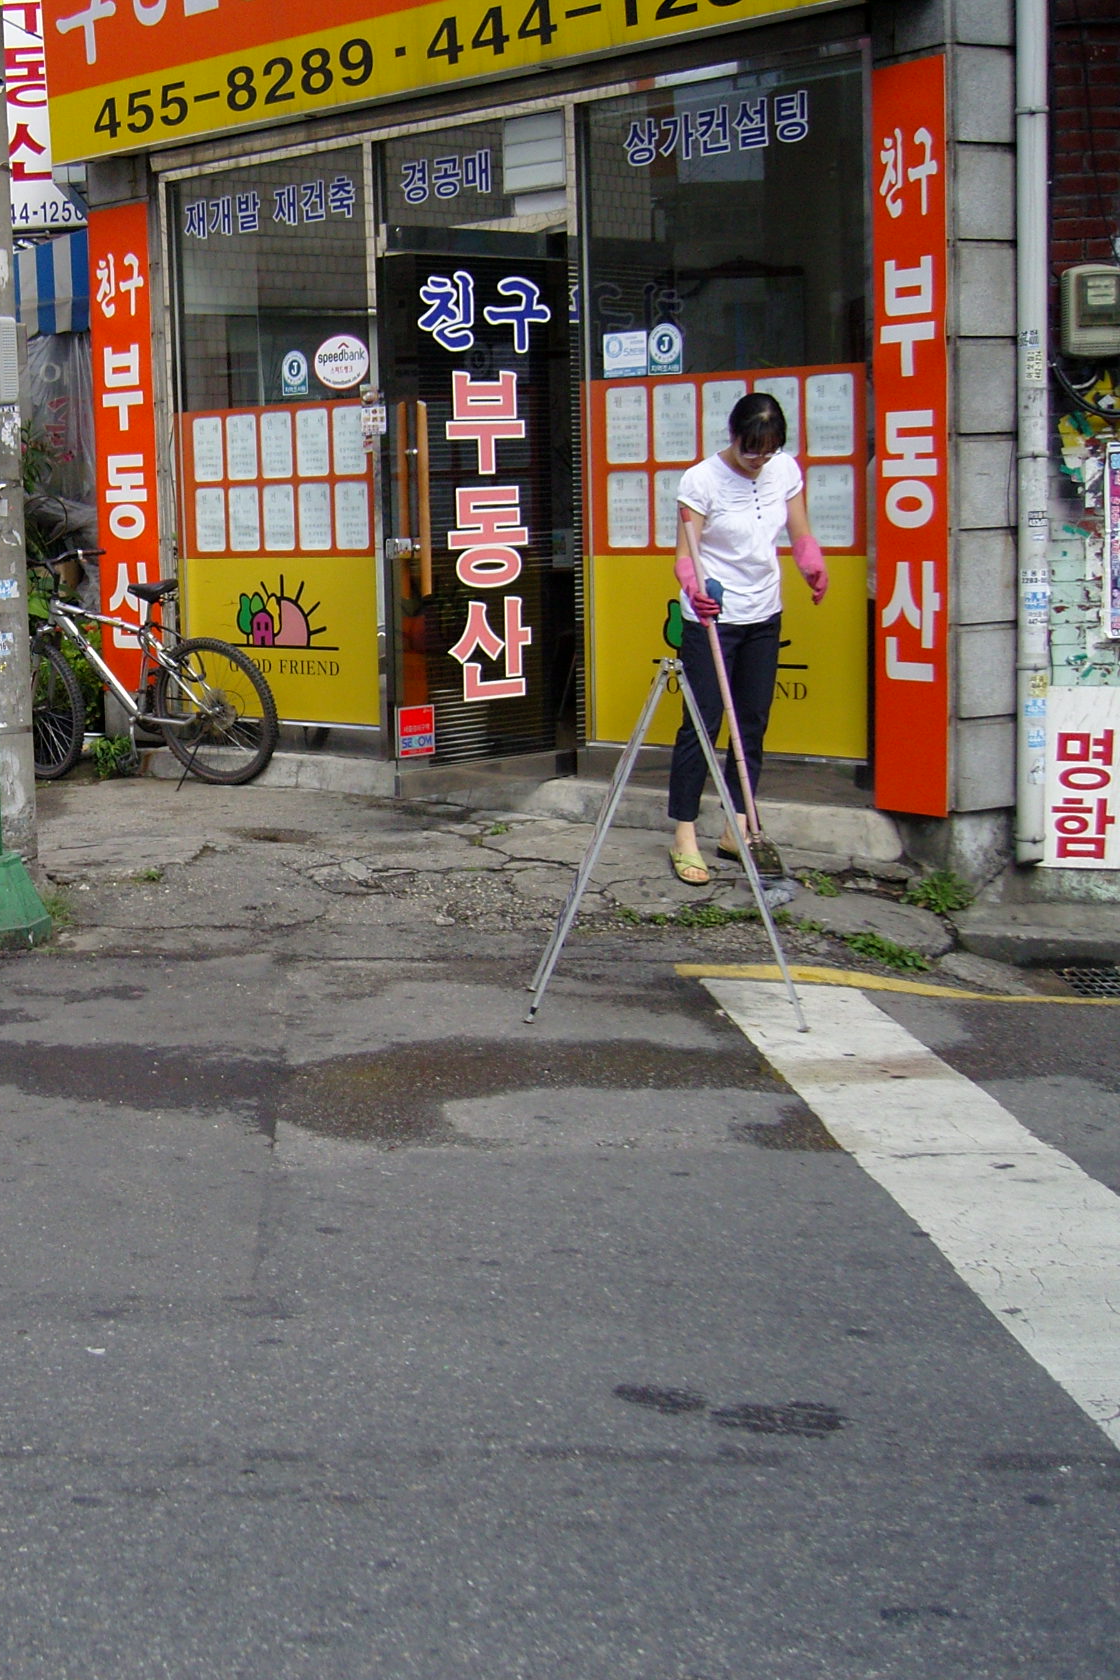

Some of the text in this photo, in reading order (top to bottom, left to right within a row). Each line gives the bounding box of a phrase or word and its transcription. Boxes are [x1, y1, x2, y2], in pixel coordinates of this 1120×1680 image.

[93, 0, 744, 139] 455-8289 444-1
[623, 90, 809, 167] 상가컨설팅
[184, 176, 356, 240] 재개발 재건축
[401, 149, 492, 204] 경공매
[879, 127, 938, 218] 친구
[96, 252, 144, 319] 친구
[417, 270, 551, 353] 친구
[317, 347, 366, 366] speedbank
[102, 343, 147, 651] 부동산
[880, 255, 941, 682] 부동산
[445, 370, 532, 702] 부동산
[229, 657, 340, 676] GOD FRIEND
[401, 735, 433, 749] SECOM
[1050, 729, 1116, 859] 명함
